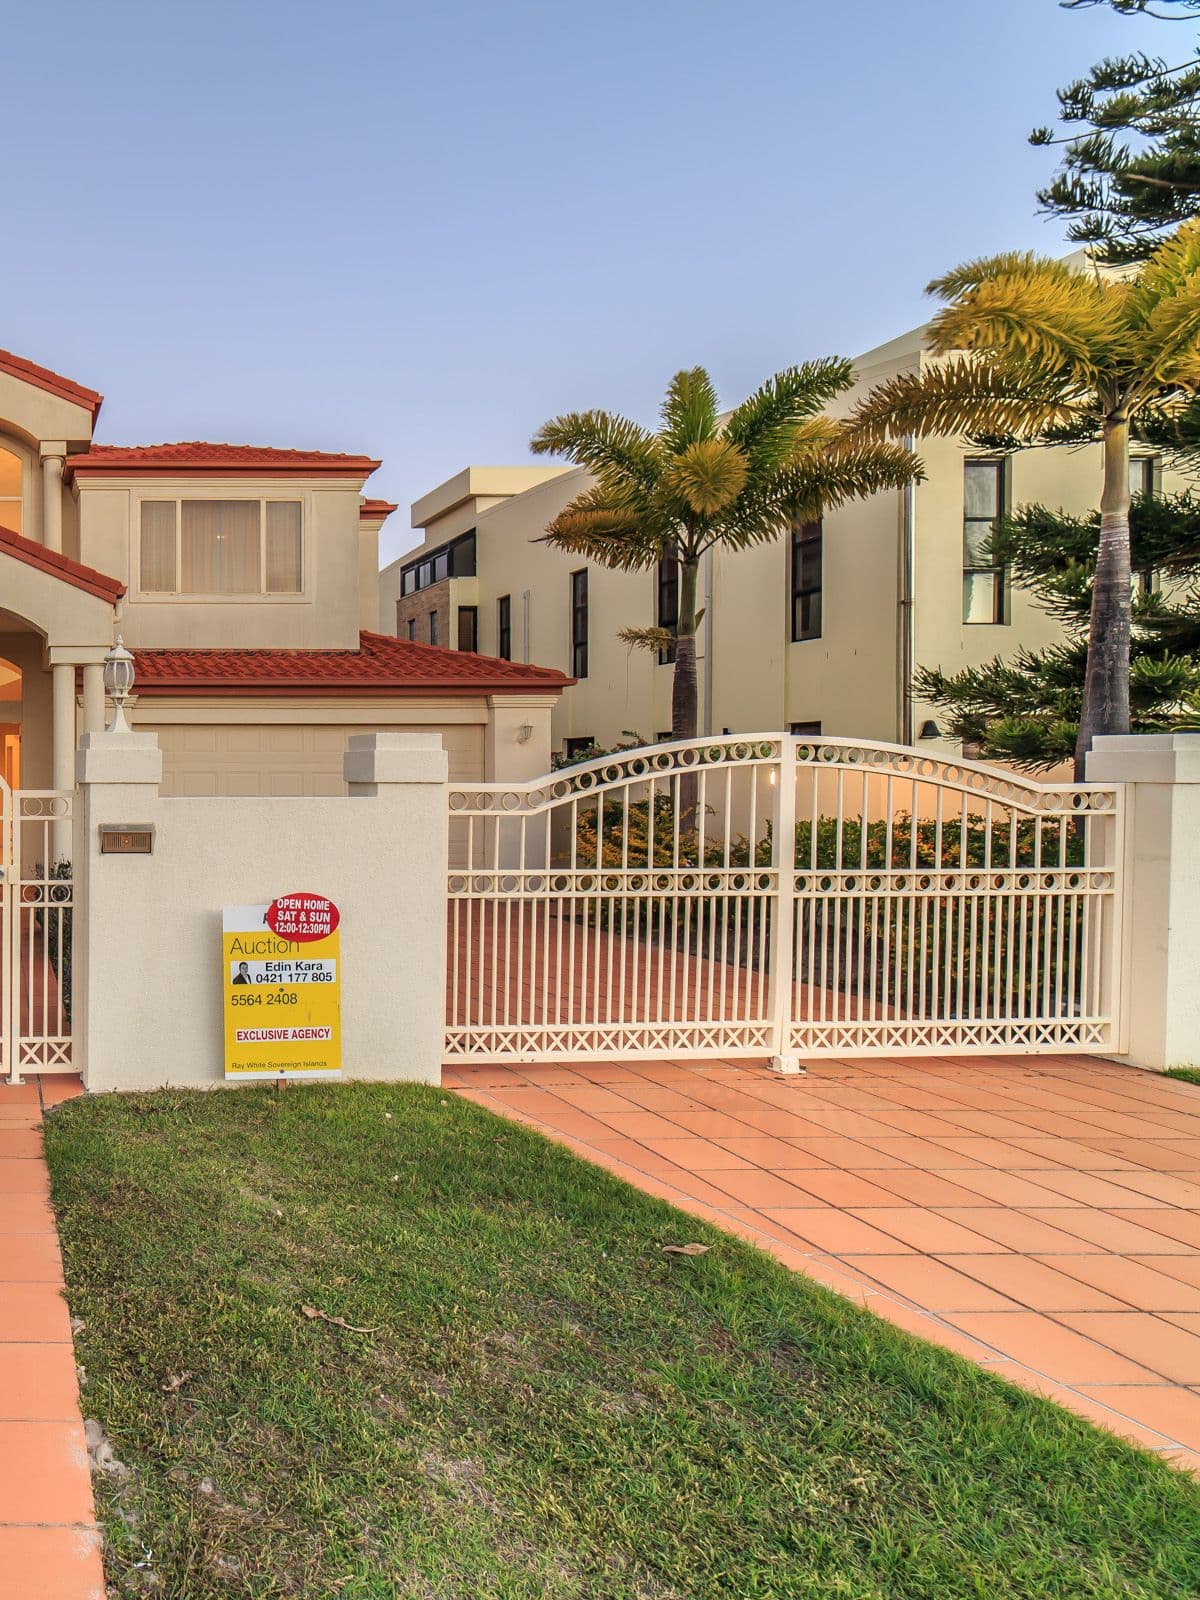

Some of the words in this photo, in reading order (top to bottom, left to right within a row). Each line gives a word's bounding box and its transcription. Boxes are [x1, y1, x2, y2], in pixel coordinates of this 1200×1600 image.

[277, 899, 302, 909] OPEN
[303, 900, 330, 911] HOME
[277, 911, 297, 921] SAT
[299, 912, 307, 922] &
[309, 912, 331, 923] SUN
[274, 922, 331, 934] 12:00-12:30PM
[229, 937, 300, 955] Auction
[265, 962, 292, 972] Edin
[295, 961, 323, 971] Kara
[256, 973, 283, 983] 0421
[287, 973, 308, 982] 177
[311, 972, 333, 982] 805
[231, 994, 262, 1006] 5564
[266, 993, 298, 1005] 2408
[236, 1029, 289, 1041] EXCLUSIVE
[291, 1028, 330, 1039] AGENCY
[232, 1062, 245, 1070] Ray
[267, 1061, 302, 1069] Sovereign
